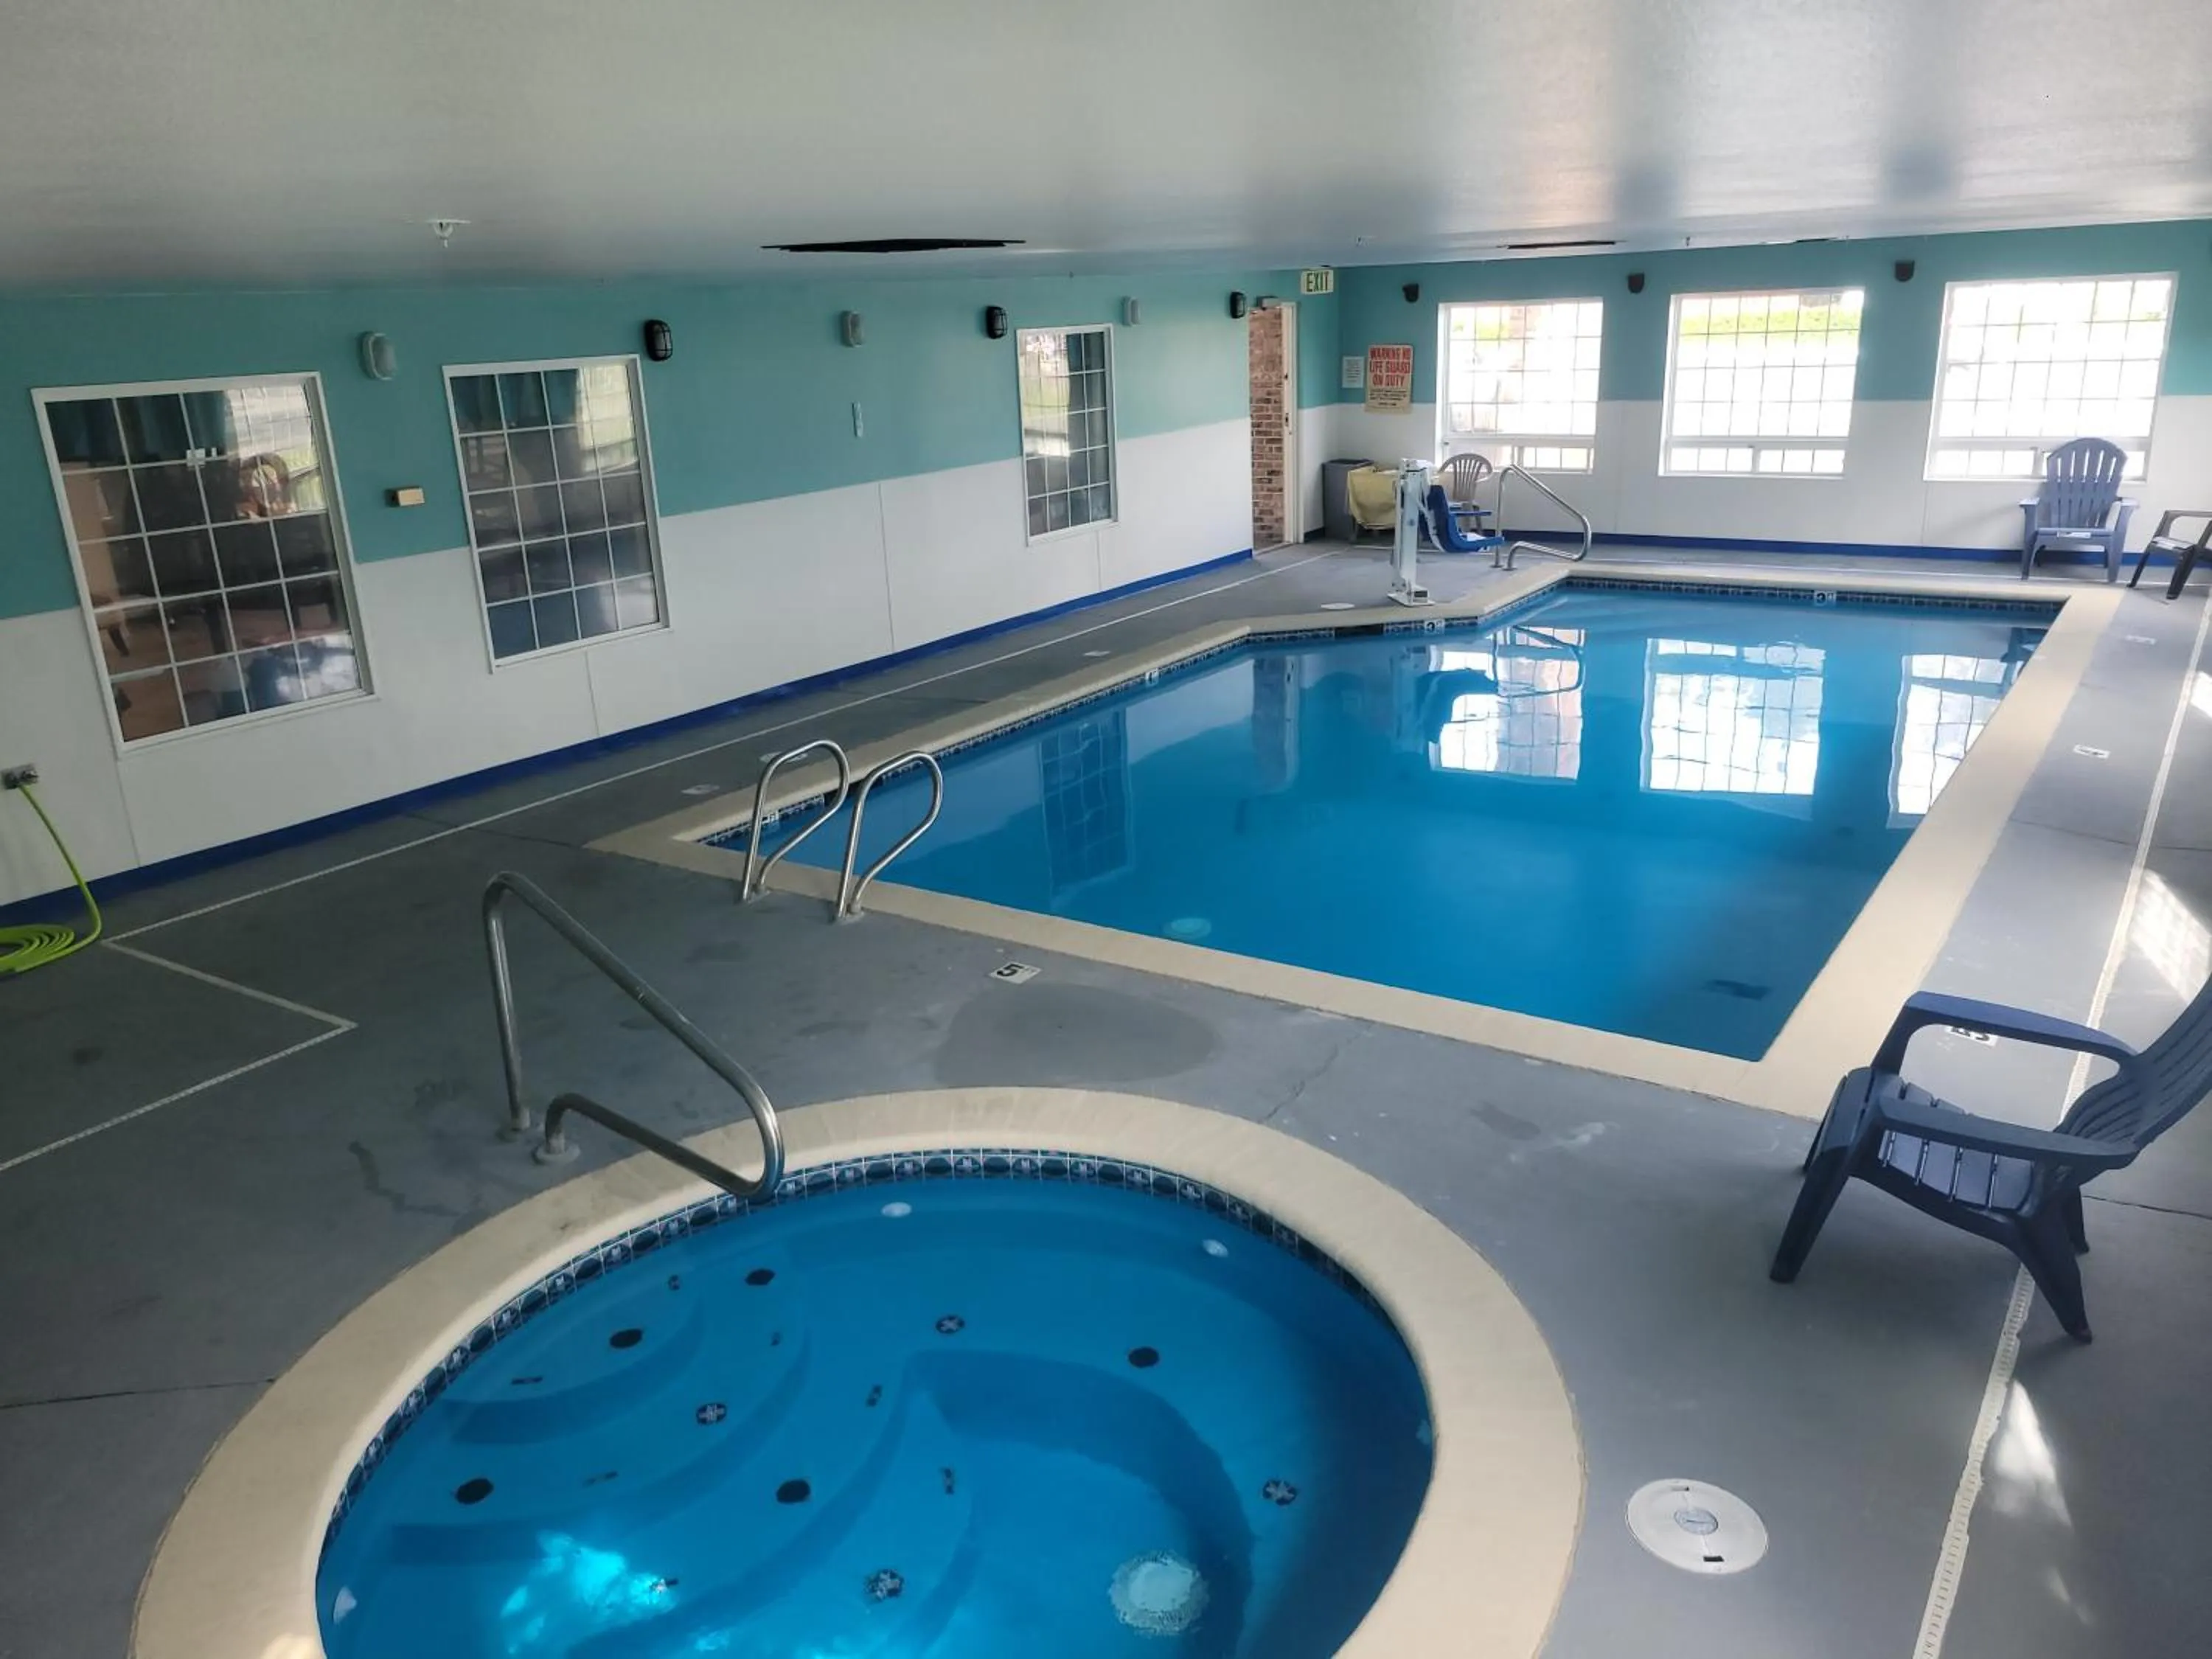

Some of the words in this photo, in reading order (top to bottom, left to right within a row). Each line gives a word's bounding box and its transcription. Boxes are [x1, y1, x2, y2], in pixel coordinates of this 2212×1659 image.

[1306, 271, 1329, 292] EXIT
[1369, 361, 1383, 373] LIFE
[1372, 374, 1384, 386] ON
[1385, 374, 1405, 386] DUTY
[996, 963, 1024, 977] 5
